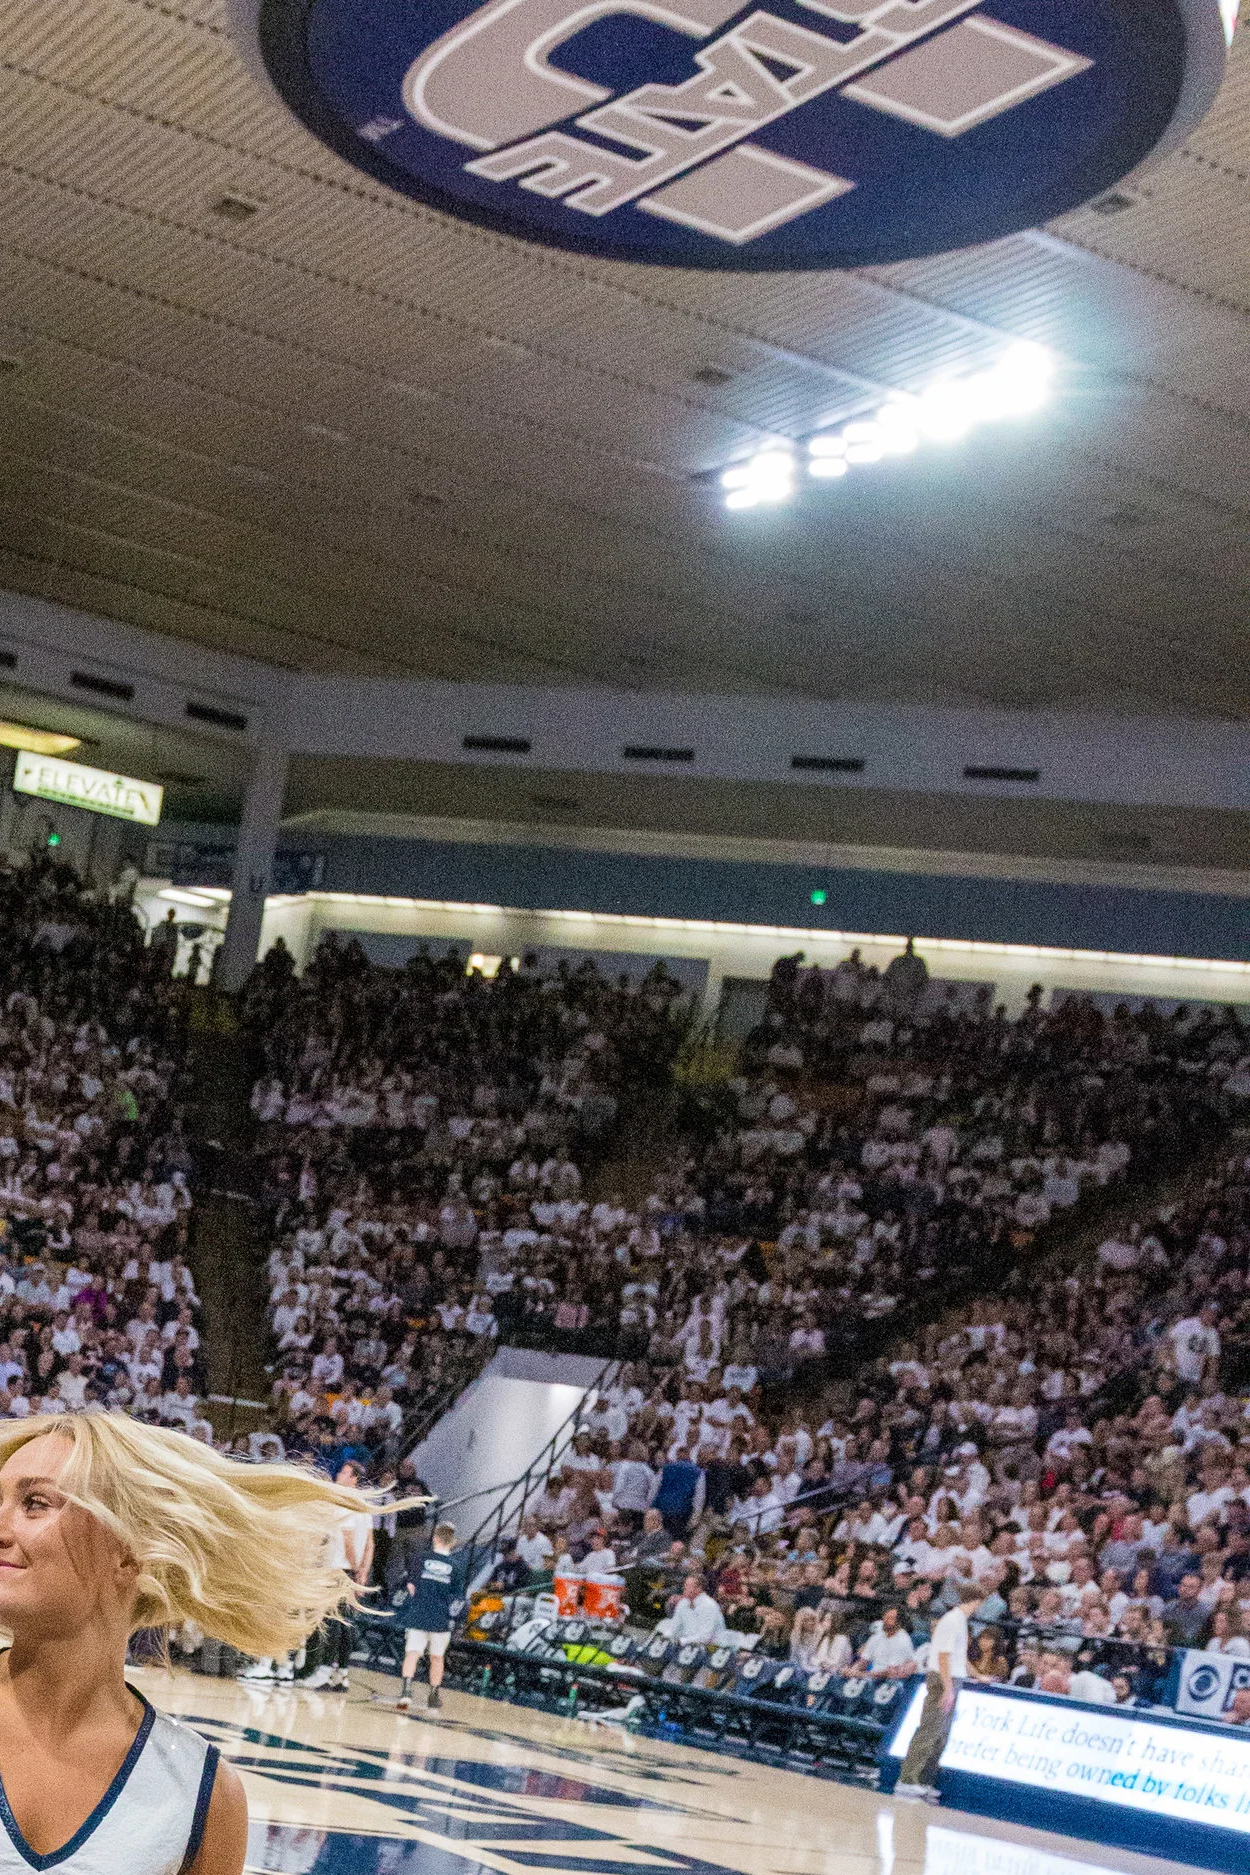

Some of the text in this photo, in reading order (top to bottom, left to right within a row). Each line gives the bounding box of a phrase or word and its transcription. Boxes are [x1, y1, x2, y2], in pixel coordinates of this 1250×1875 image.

[464, 0, 982, 216] TATE
[38, 767, 140, 808] ELEVATE
[971, 1704, 1014, 1732] York
[1017, 1713, 1058, 1740] Life
[1061, 1721, 1136, 1757] doesn't
[1141, 1737, 1194, 1768] have
[1004, 1743, 1062, 1781] being
[1067, 1761, 1141, 1790] owned
[1142, 1771, 1169, 1803] by
[1174, 1781, 1230, 1809] folks
